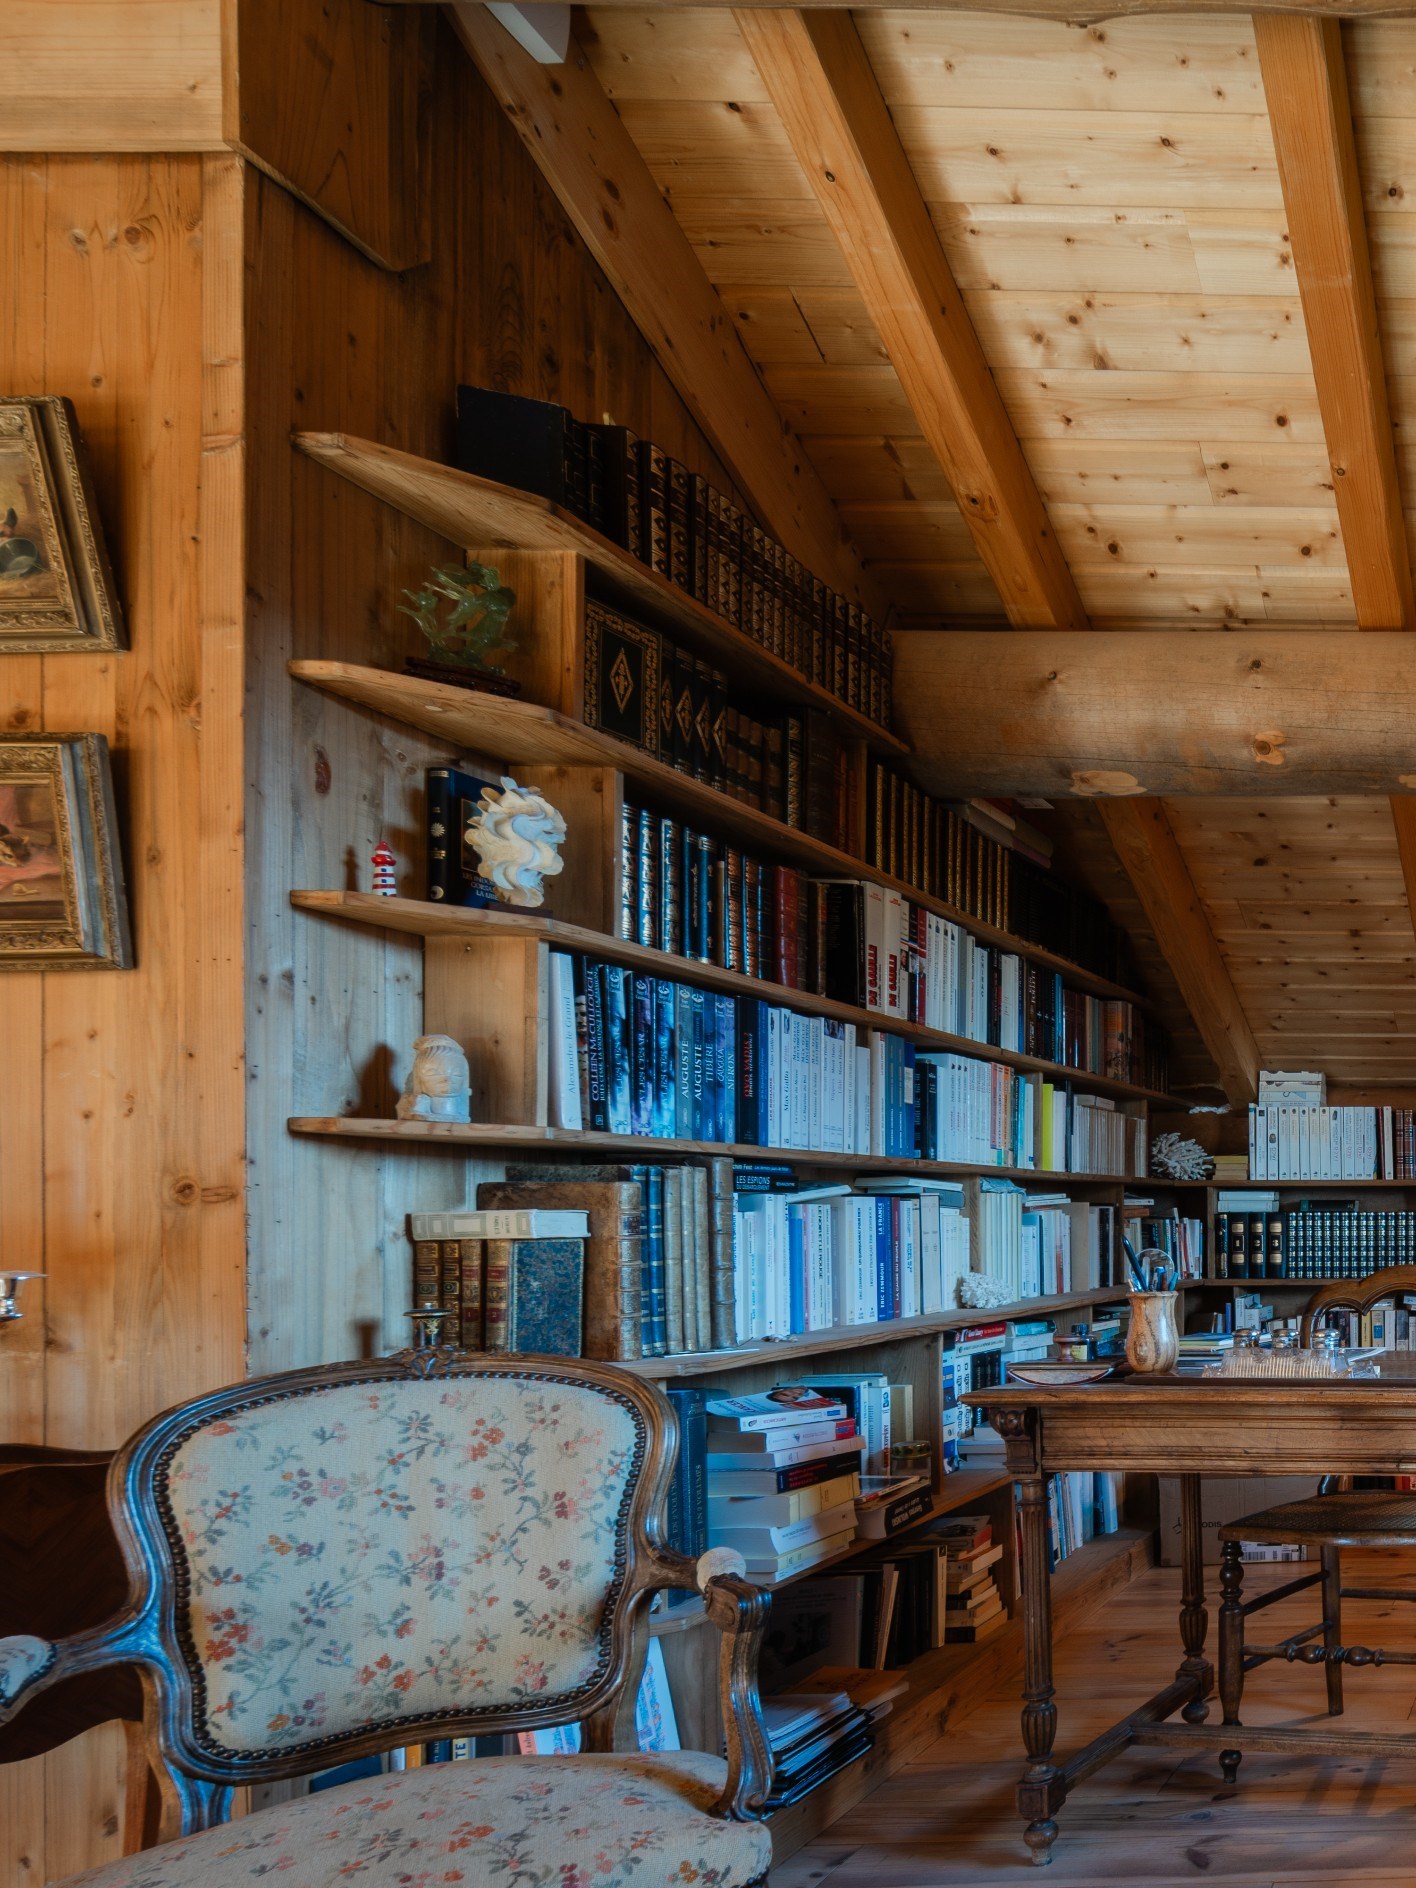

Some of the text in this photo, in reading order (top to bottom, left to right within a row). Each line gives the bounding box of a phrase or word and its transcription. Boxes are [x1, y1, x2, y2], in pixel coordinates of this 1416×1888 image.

[868, 944, 877, 1006] DE GAULLE
[889, 954, 897, 1007] DE GAULLE
[565, 1031, 572, 1040] le
[587, 970, 599, 1101] COLLEEN McCULLOUGH
[566, 1044, 576, 1093] Alexandre
[747, 1176, 770, 1184] ESPIONS
[697, 1512, 702, 1524] EN
